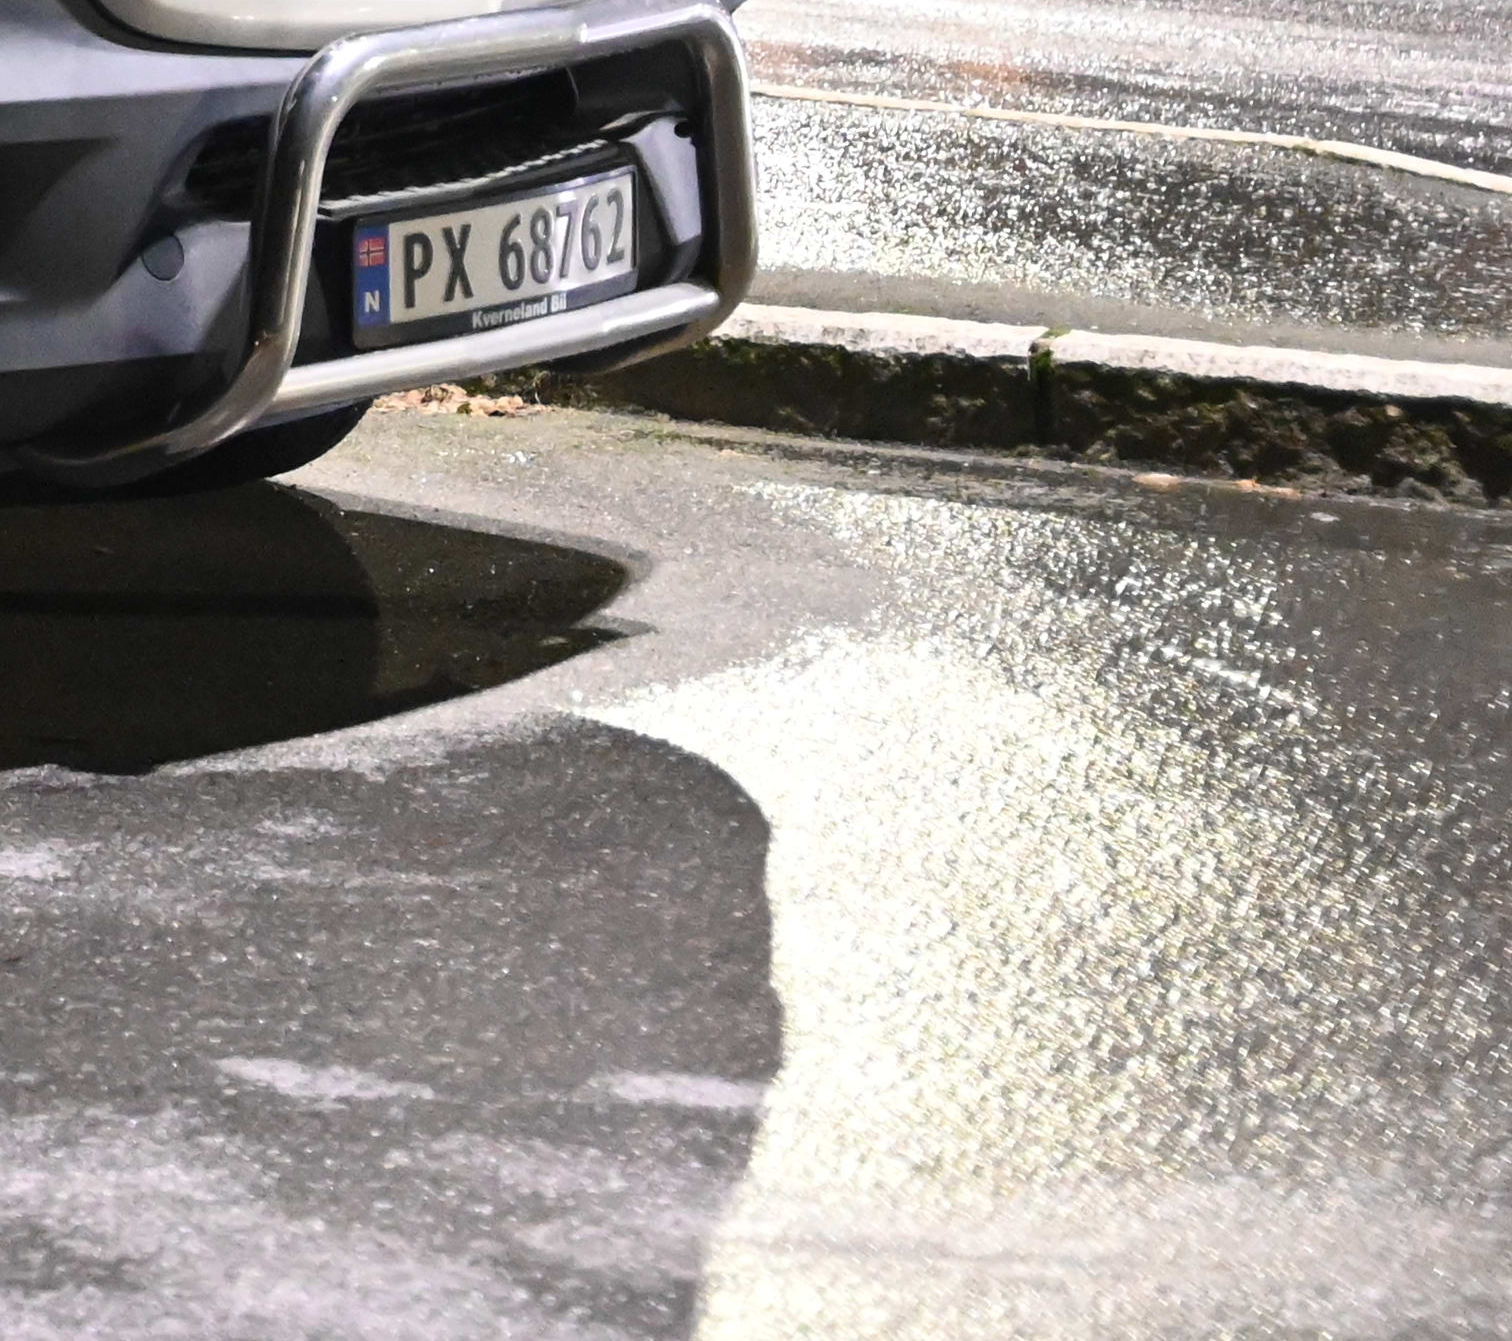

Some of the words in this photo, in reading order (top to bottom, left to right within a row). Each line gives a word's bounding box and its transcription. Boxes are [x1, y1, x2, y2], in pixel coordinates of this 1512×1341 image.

[403, 223, 474, 308] PX
[499, 187, 625, 290] 68762
[363, 290, 381, 314] N
[472, 297, 549, 330] Kverneland
[550, 293, 567, 313] Bil
